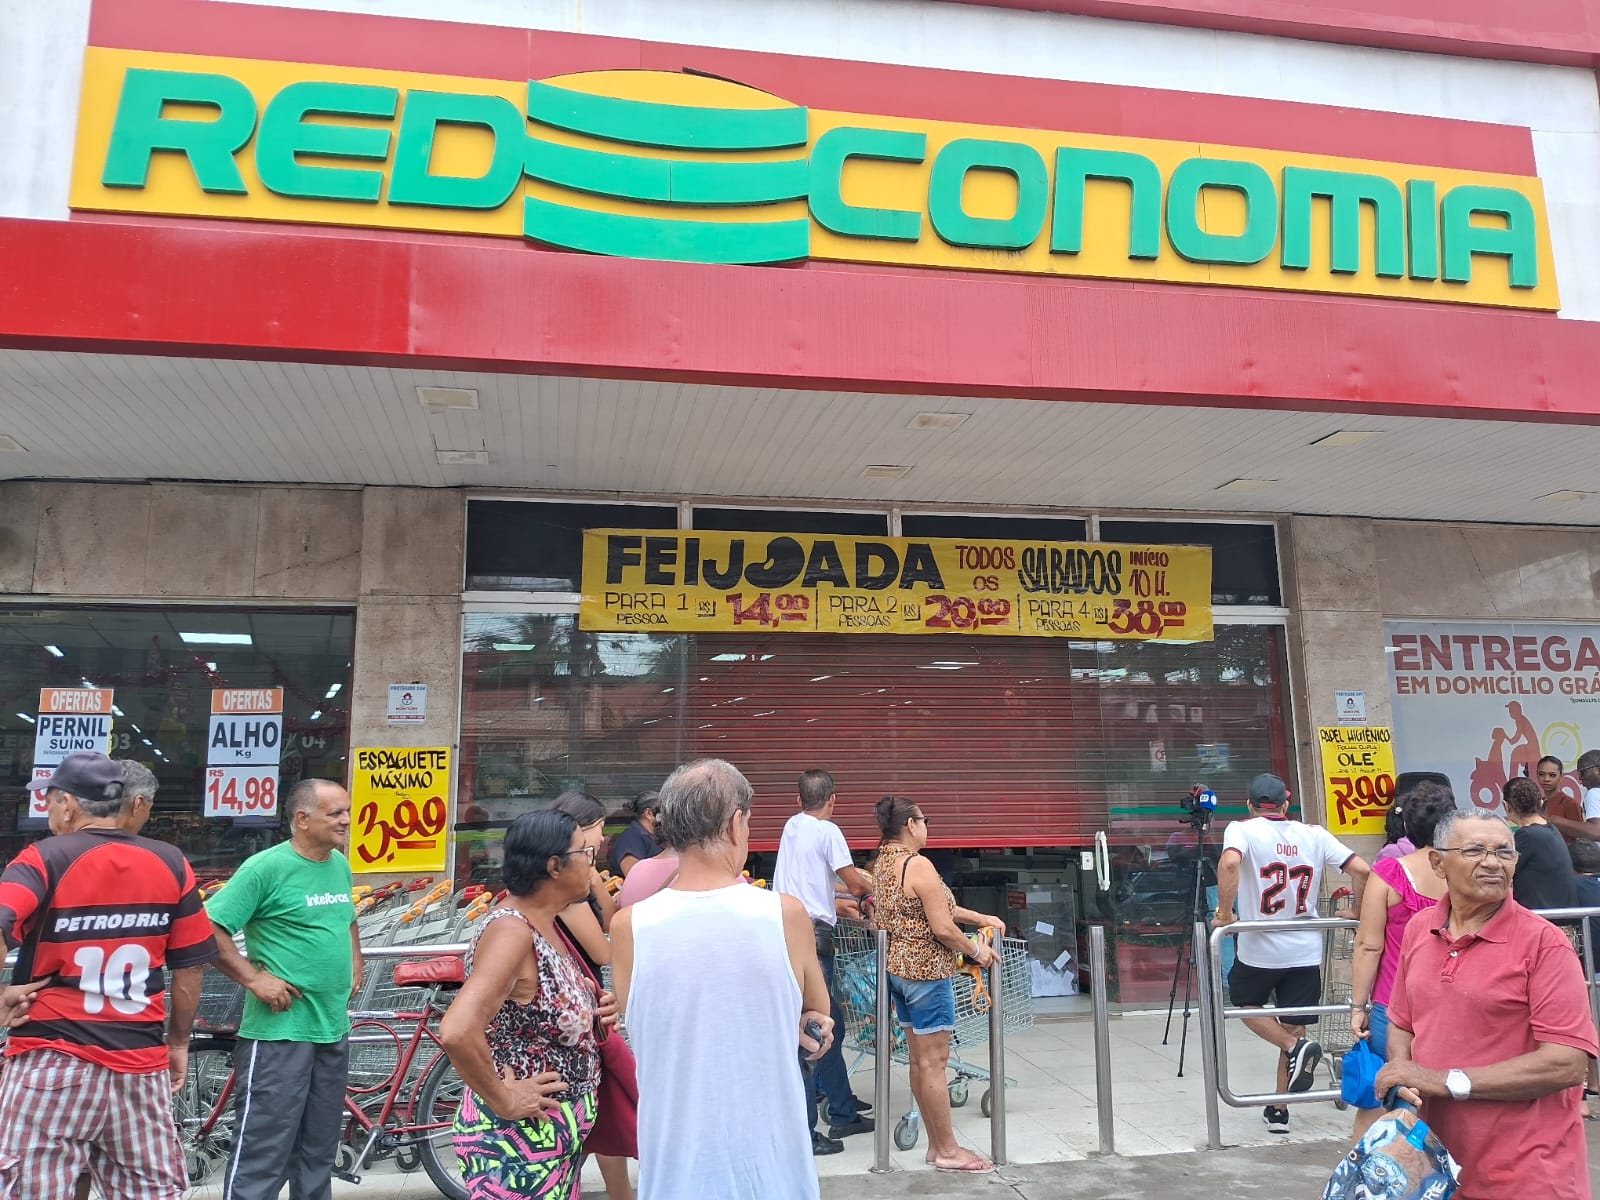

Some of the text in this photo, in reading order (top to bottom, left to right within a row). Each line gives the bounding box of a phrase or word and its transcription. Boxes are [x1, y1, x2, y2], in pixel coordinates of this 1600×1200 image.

[955, 545, 1016, 570] TODOS
[972, 575, 999, 592] OS
[1128, 569, 1150, 598] 10
[605, 592, 666, 611] PARA
[676, 592, 689, 611] 1
[829, 595, 880, 613] PARA
[886, 595, 898, 614] 2
[1028, 599, 1074, 619] PARA
[1078, 600, 1090, 619] 4
[616, 612, 669, 625] PESSOA
[838, 613, 892, 628] PESSOAS
[1036, 617, 1081, 632] PESSOAS
[1391, 634, 1600, 672] ENTREGA
[1396, 676, 1430, 694] EM
[1436, 671, 1554, 695] DOMICÍLIO
[50, 690, 102, 711] OFERTAS
[222, 690, 273, 710] OFERTAS
[39, 717, 108, 737] PERNIL
[212, 721, 279, 748] ALHO
[49, 737, 95, 750] SUÍNO
[235, 749, 252, 759] Kg
[359, 751, 447, 770] ESPAGUETE
[370, 771, 433, 789] MÁXIMO
[208, 777, 275, 814] 14,98
[1276, 843, 1298, 857] DIDA
[1260, 862, 1314, 915] 27
[54, 912, 170, 933] PETROBRAS
[74, 944, 151, 1015] 10
